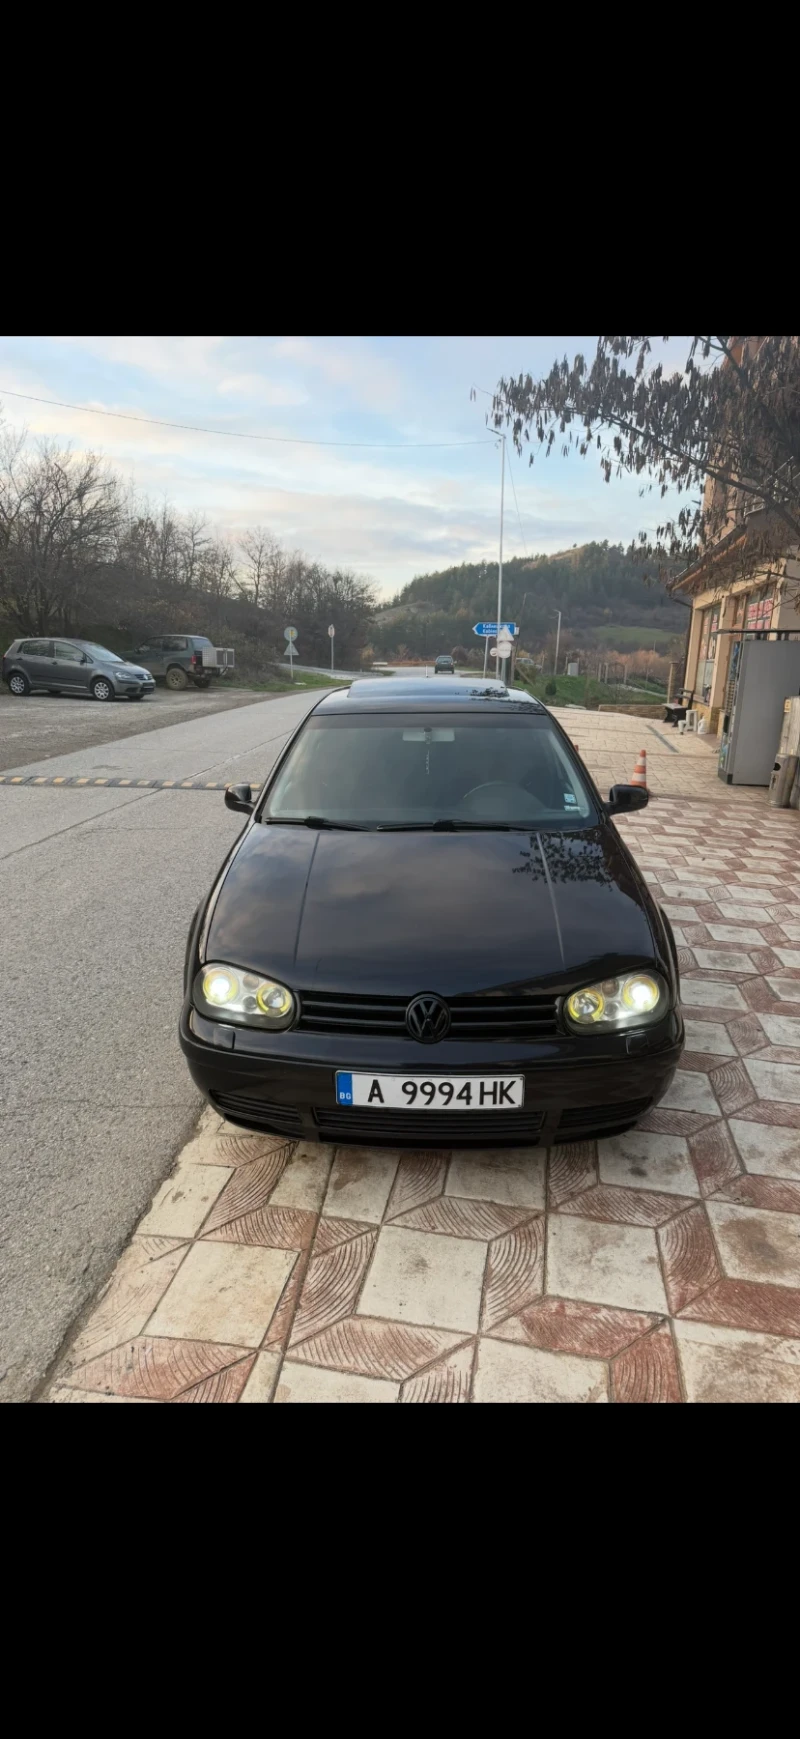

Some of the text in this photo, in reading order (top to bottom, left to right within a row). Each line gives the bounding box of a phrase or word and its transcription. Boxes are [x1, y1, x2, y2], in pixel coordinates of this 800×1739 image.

[339, 1092, 352, 1100] BG
[367, 1079, 385, 1104] A
[401, 1081, 472, 1106] 9994
